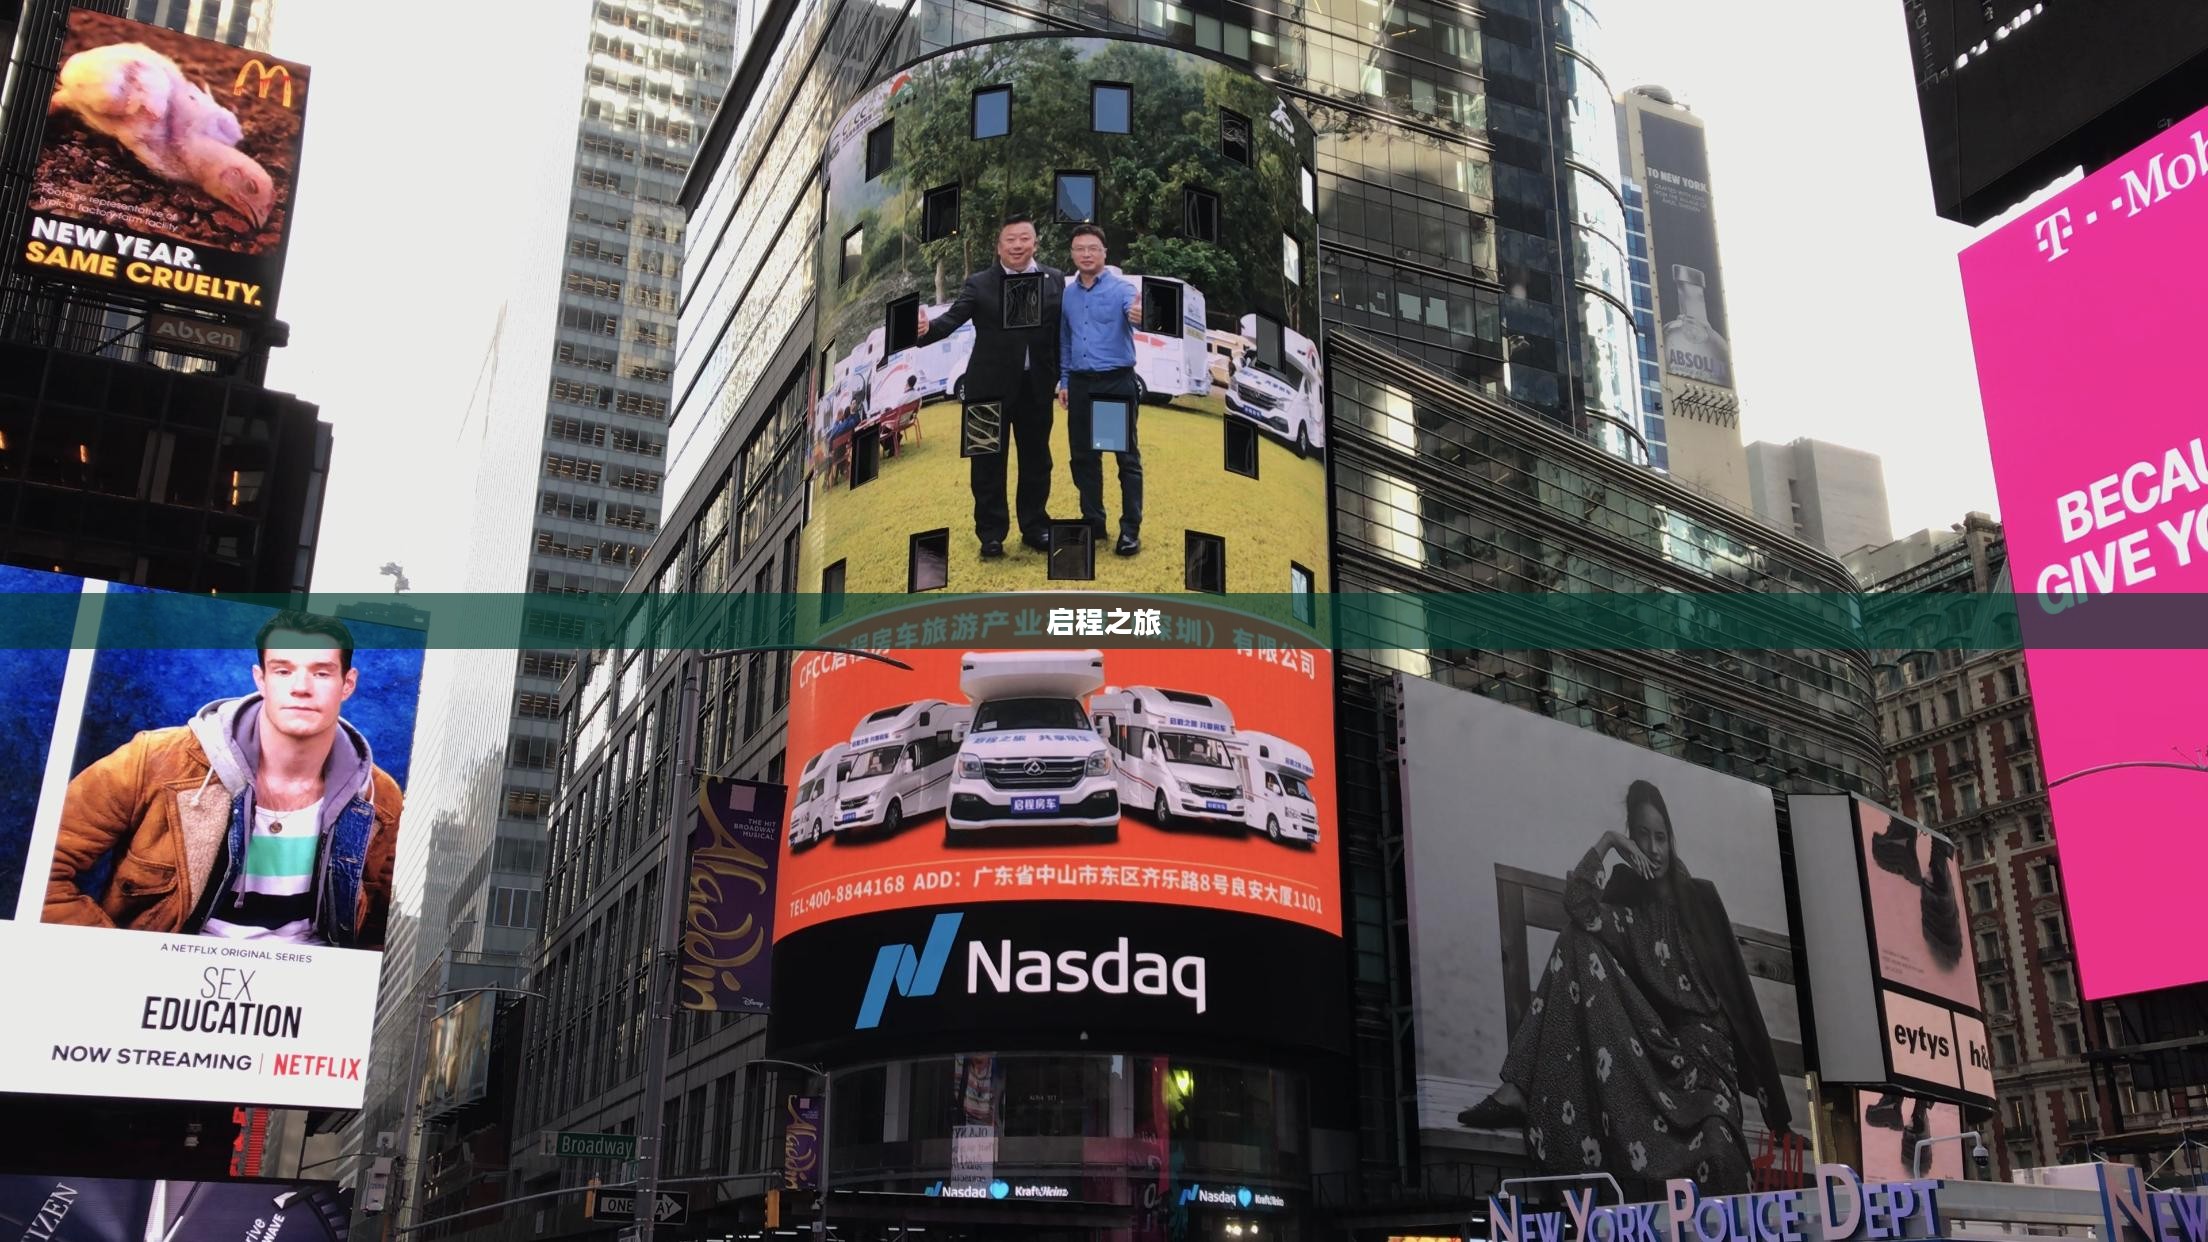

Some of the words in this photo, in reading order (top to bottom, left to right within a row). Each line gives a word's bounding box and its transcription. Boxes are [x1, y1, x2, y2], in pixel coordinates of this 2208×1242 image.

[1647, 167, 1659, 179] TO
[1660, 171, 1681, 185] NEW
[39, 195, 76, 212] typical
[143, 217, 179, 233] facility
[40, 184, 87, 203] Footage
[89, 195, 164, 219] representative
[31, 216, 109, 250] NEW
[114, 232, 203, 270] YEAR.
[25, 240, 118, 278] SAME
[126, 261, 264, 307] CRUELTY.
[156, 321, 236, 348] Absen
[2036, 528, 2157, 615] GIVE
[733, 823, 775, 833] BROADWAY
[742, 830, 775, 840] MUSICAL
[748, 818, 762, 826] THE
[764, 820, 776, 828] HIT
[160, 943, 169, 952] A
[171, 943, 218, 956] NETFLIX
[221, 947, 272, 960] ORIGINAL
[275, 952, 313, 963] SERIES
[200, 966, 256, 1001] SEX
[967, 936, 1207, 1014] Nasdaq
[141, 996, 302, 1038] EDUCATION
[1894, 1023, 1950, 1060] eytys
[1969, 1040, 1991, 1072] h&
[51, 1044, 112, 1063] NOW
[116, 1047, 252, 1071] STREAMING
[273, 1053, 361, 1081] NETFLIX
[562, 1135, 633, 1160] Broadway
[608, 1199, 633, 1212] ONE
[1199, 1189, 1236, 1208] Nasdaq
[1489, 1194, 1566, 1242] NEW
[1562, 1187, 1664, 1242] YORK
[1666, 1178, 1803, 1242] POLICE
[1817, 1163, 1943, 1241] DEPT
